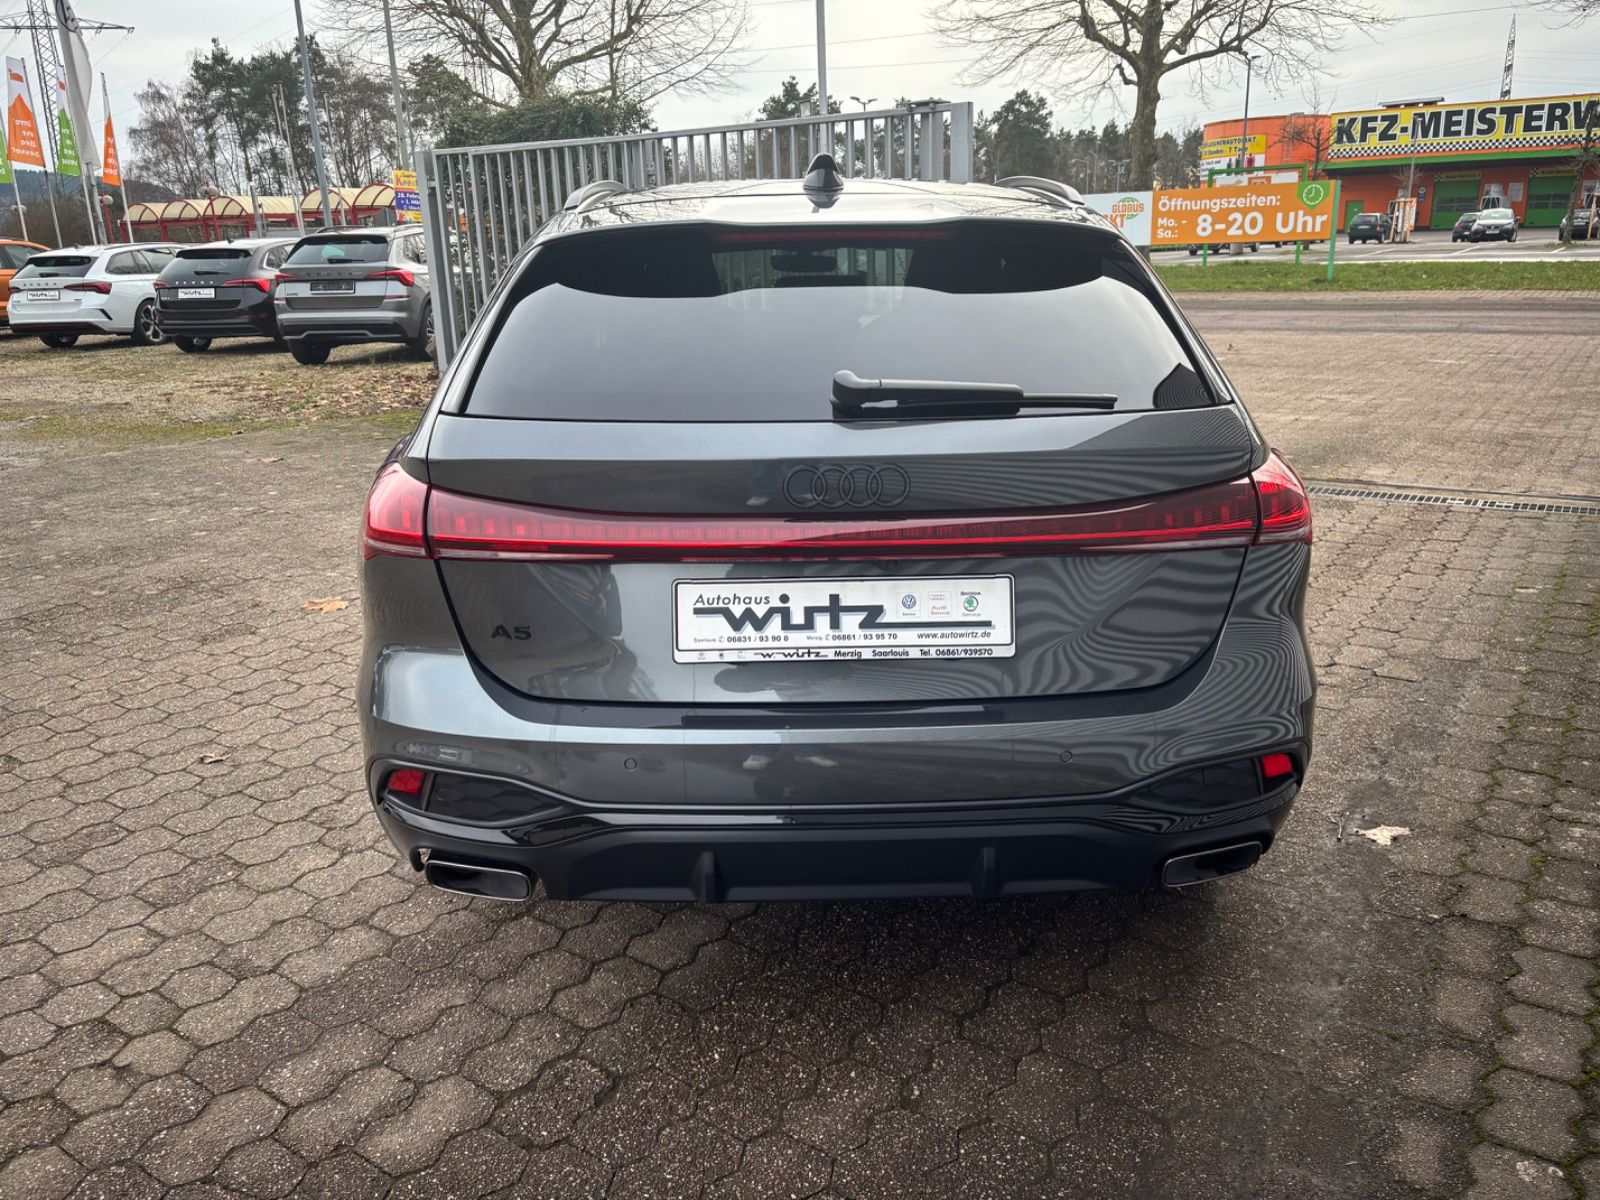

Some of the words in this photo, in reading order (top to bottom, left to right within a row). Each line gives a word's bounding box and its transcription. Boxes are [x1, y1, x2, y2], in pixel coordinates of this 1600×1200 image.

[1112, 203, 1145, 213] GLOBUS
[1158, 193, 1281, 213] Öffnungszeiten:
[1158, 217, 1178, 227] Mo.
[1196, 211, 1264, 237] 8-20
[1275, 209, 1328, 234] Uhr
[693, 593, 771, 606] Autohaus
[491, 624, 531, 640] A5
[917, 631, 992, 640] www.autowirtz.de
[834, 650, 862, 658] Merzig
[872, 649, 909, 657] Saarlouis
[920, 649, 933, 657] Tel.
